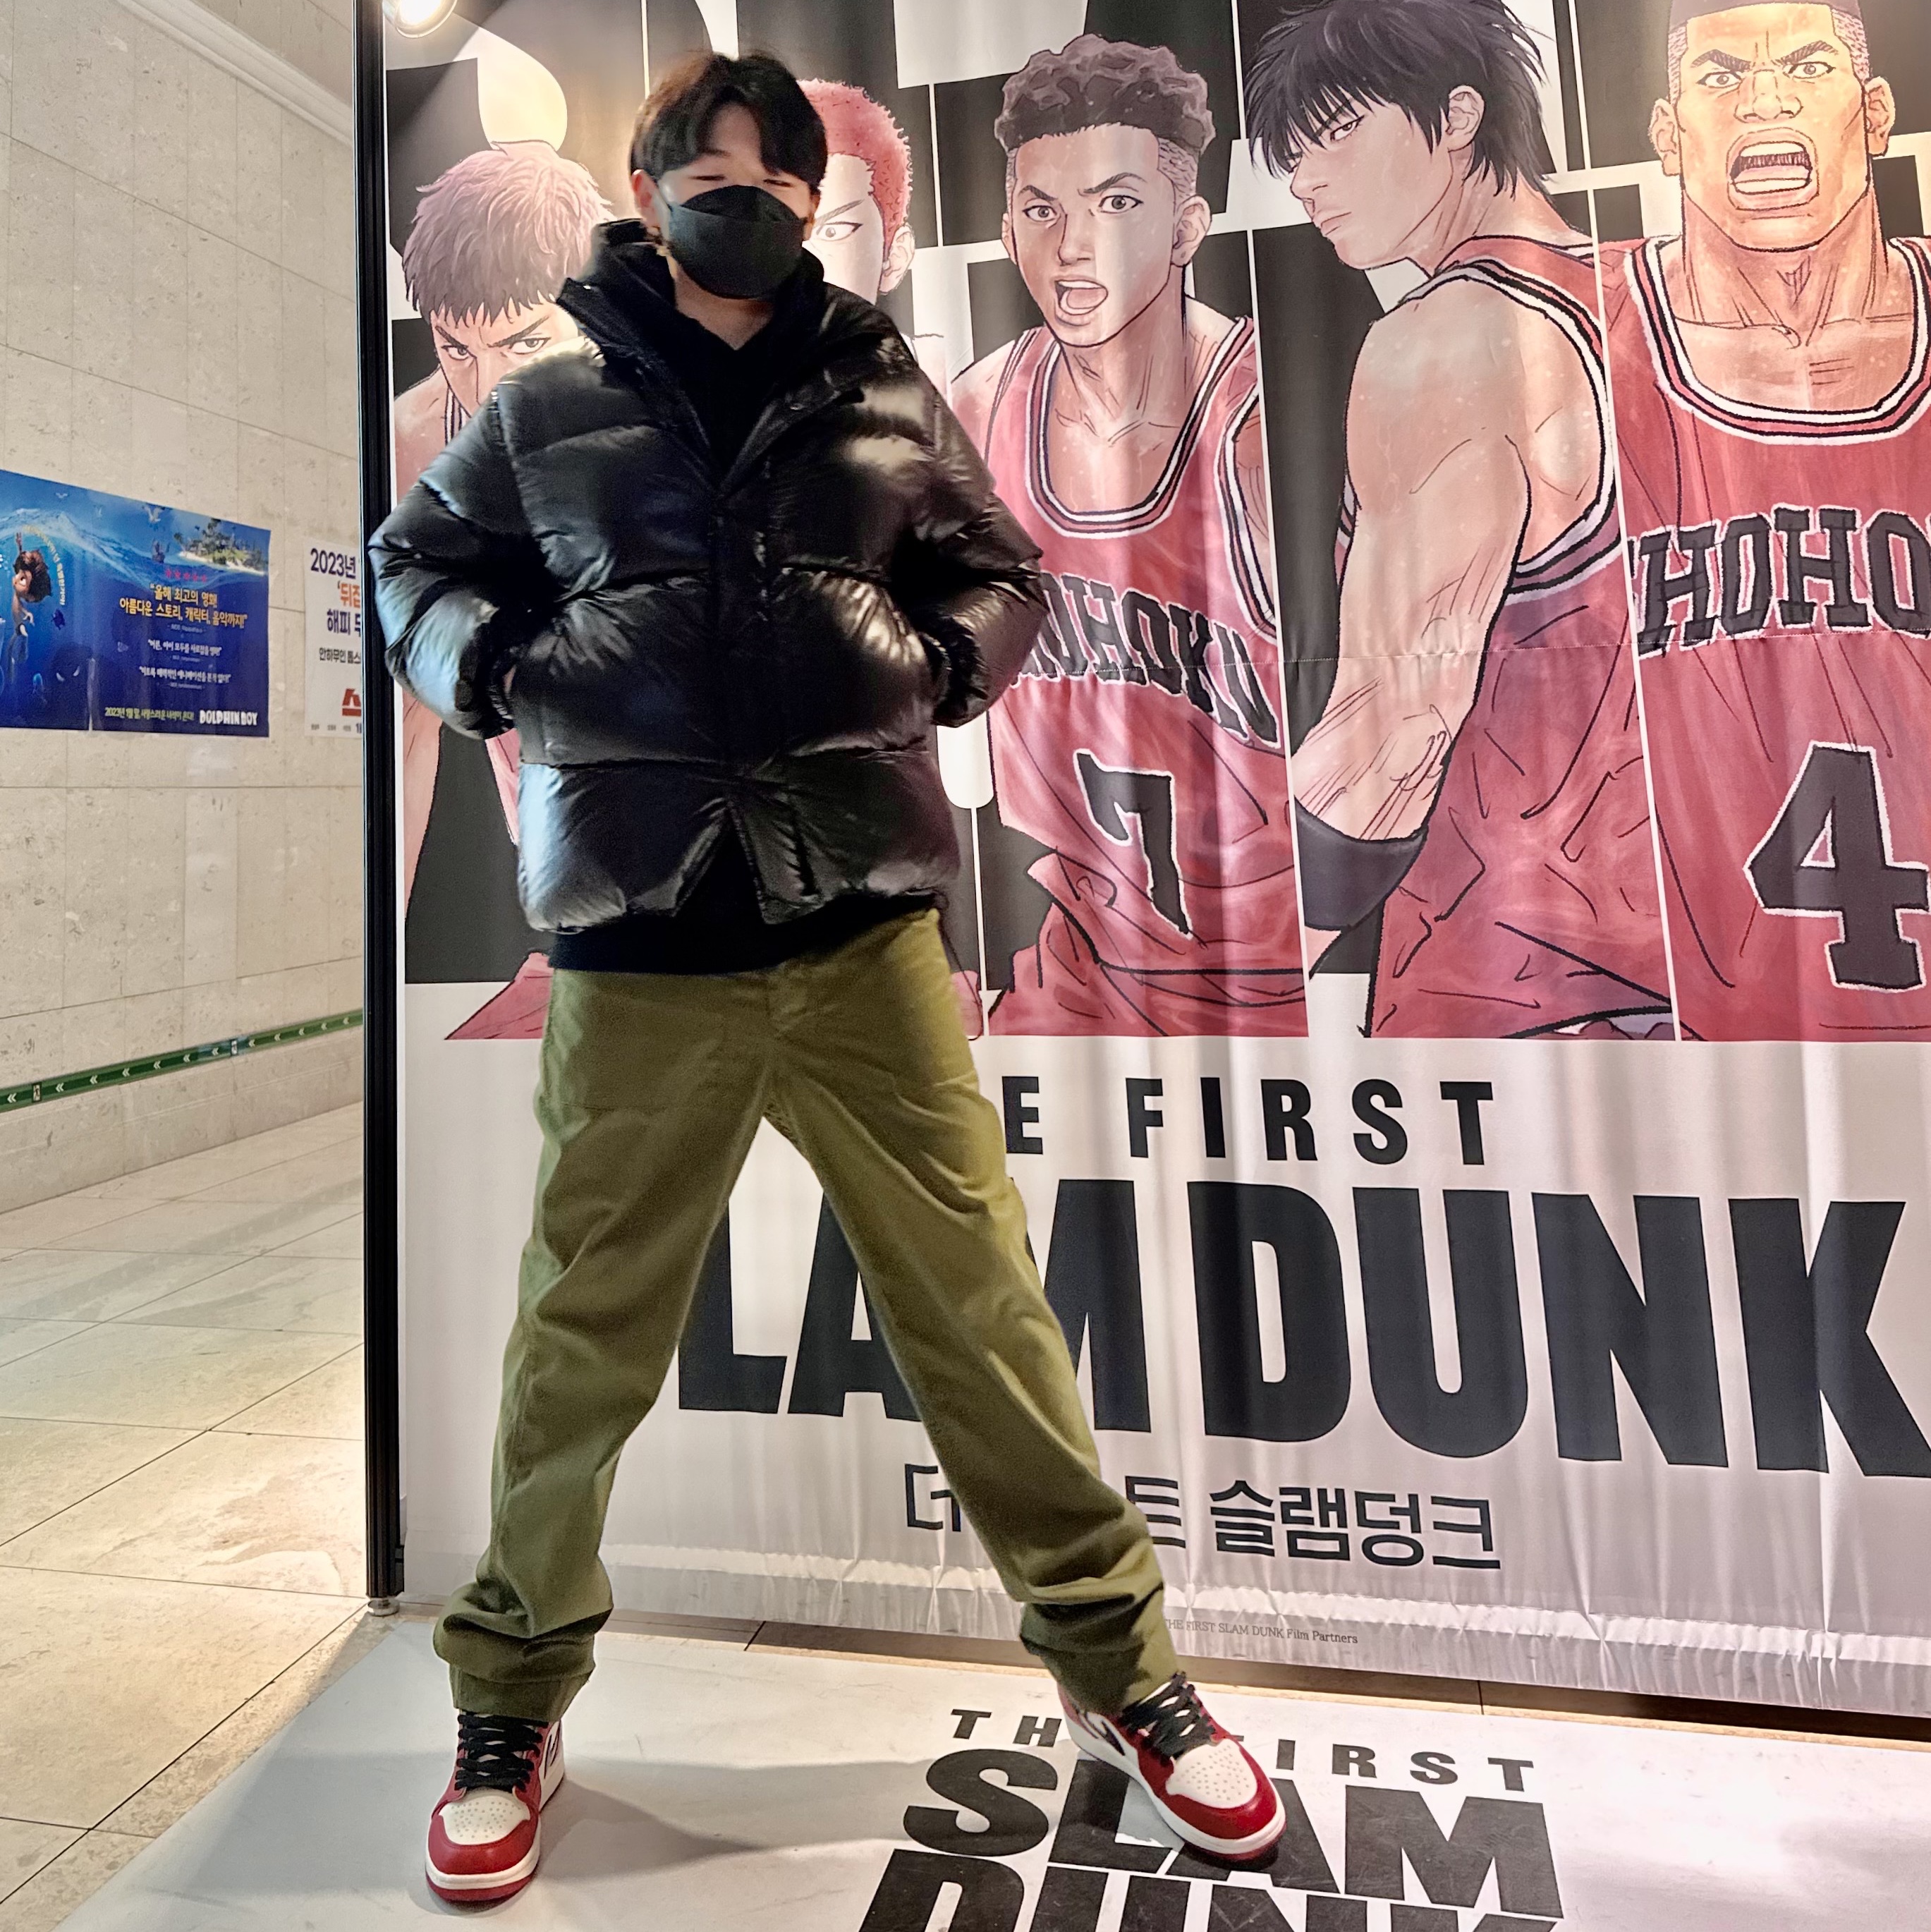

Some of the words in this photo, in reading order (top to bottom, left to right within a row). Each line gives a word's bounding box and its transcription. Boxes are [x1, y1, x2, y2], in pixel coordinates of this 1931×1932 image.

[174, 588, 199, 605] 최고의
[310, 547, 356, 579] 2023년
[1628, 504, 1931, 659] HOHO
[119, 597, 153, 617] 아름다운
[155, 603, 183, 621] 스토리,
[327, 609, 351, 636] 해피
[1010, 570, 1281, 749] OHOKU
[200, 710, 240, 725] DOLPHIN
[240, 711, 257, 726] BOY
[1073, 748, 1193, 940] 7
[1743, 741, 1930, 992] 4
[1125, 1076, 1494, 1165] FIRST
[678, 1179, 1151, 1433] LAM
[1188, 1181, 1931, 1478] DUNK
[1210, 1479, 1501, 1570] 슬램덩크
[1186, 1620, 1216, 1633] FIRST
[1219, 1623, 1249, 1635] SLAM
[1253, 1625, 1284, 1639] DUNK
[1287, 1628, 1310, 1641] Film
[1312, 1630, 1358, 1644] Partners
[951, 1708, 1062, 1748] TH
[1228, 1734, 1535, 1792] IRST
